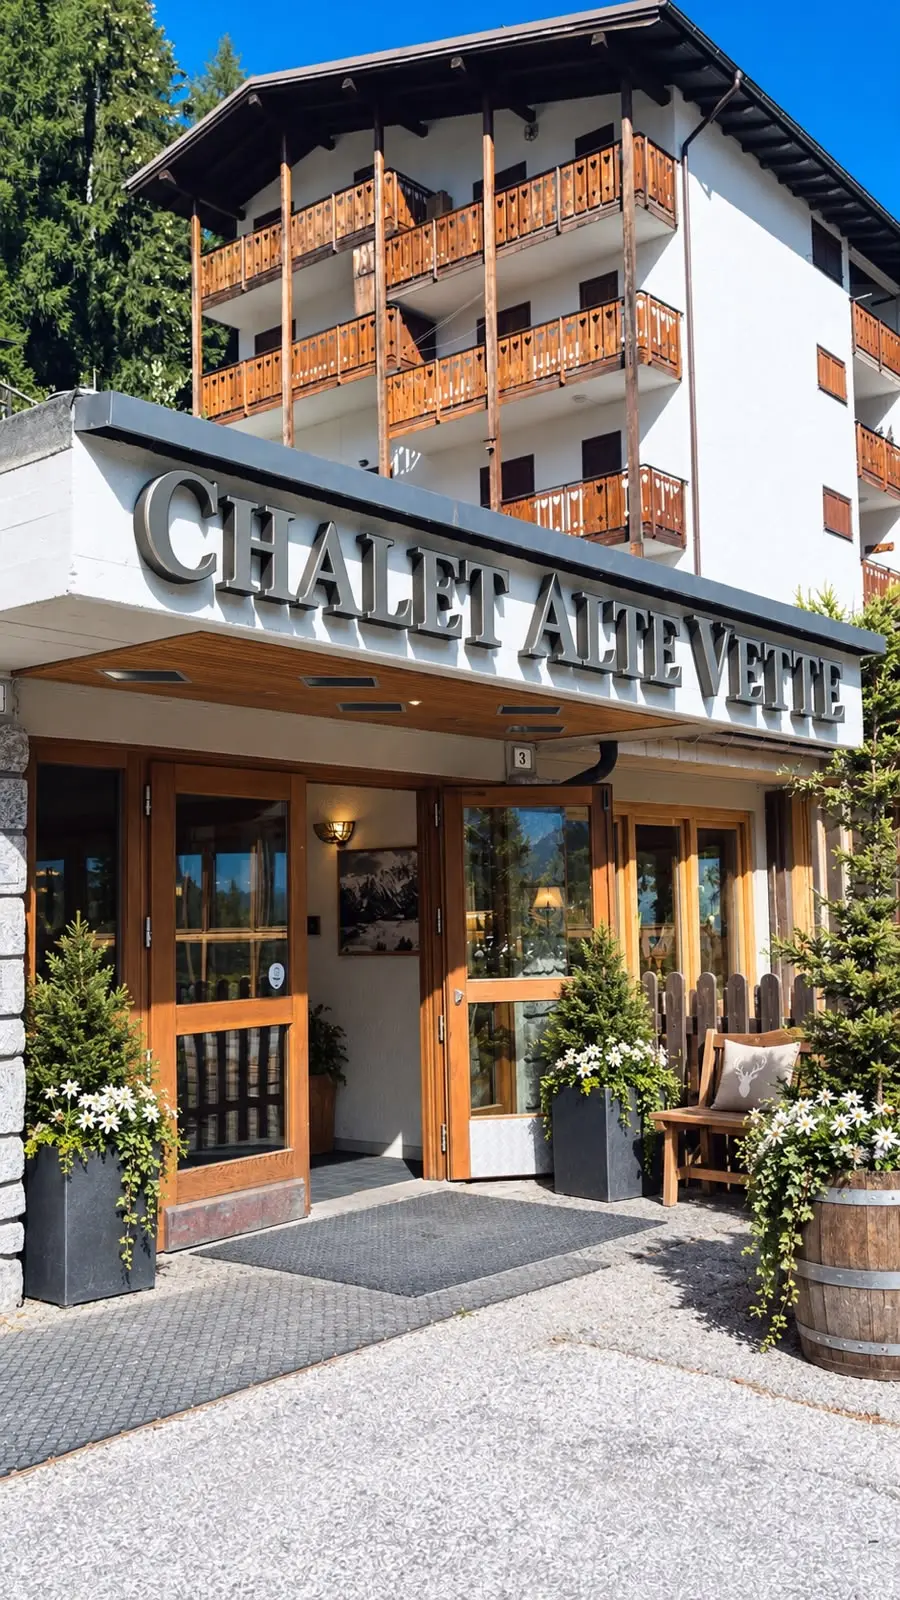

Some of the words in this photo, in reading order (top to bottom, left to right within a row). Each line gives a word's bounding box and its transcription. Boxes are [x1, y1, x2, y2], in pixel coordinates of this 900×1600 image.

[133, 470, 508, 649] CHALET
[518, 572, 682, 688] ALTE
[684, 614, 845, 723] VETTE
[519, 751, 526, 765] 3
